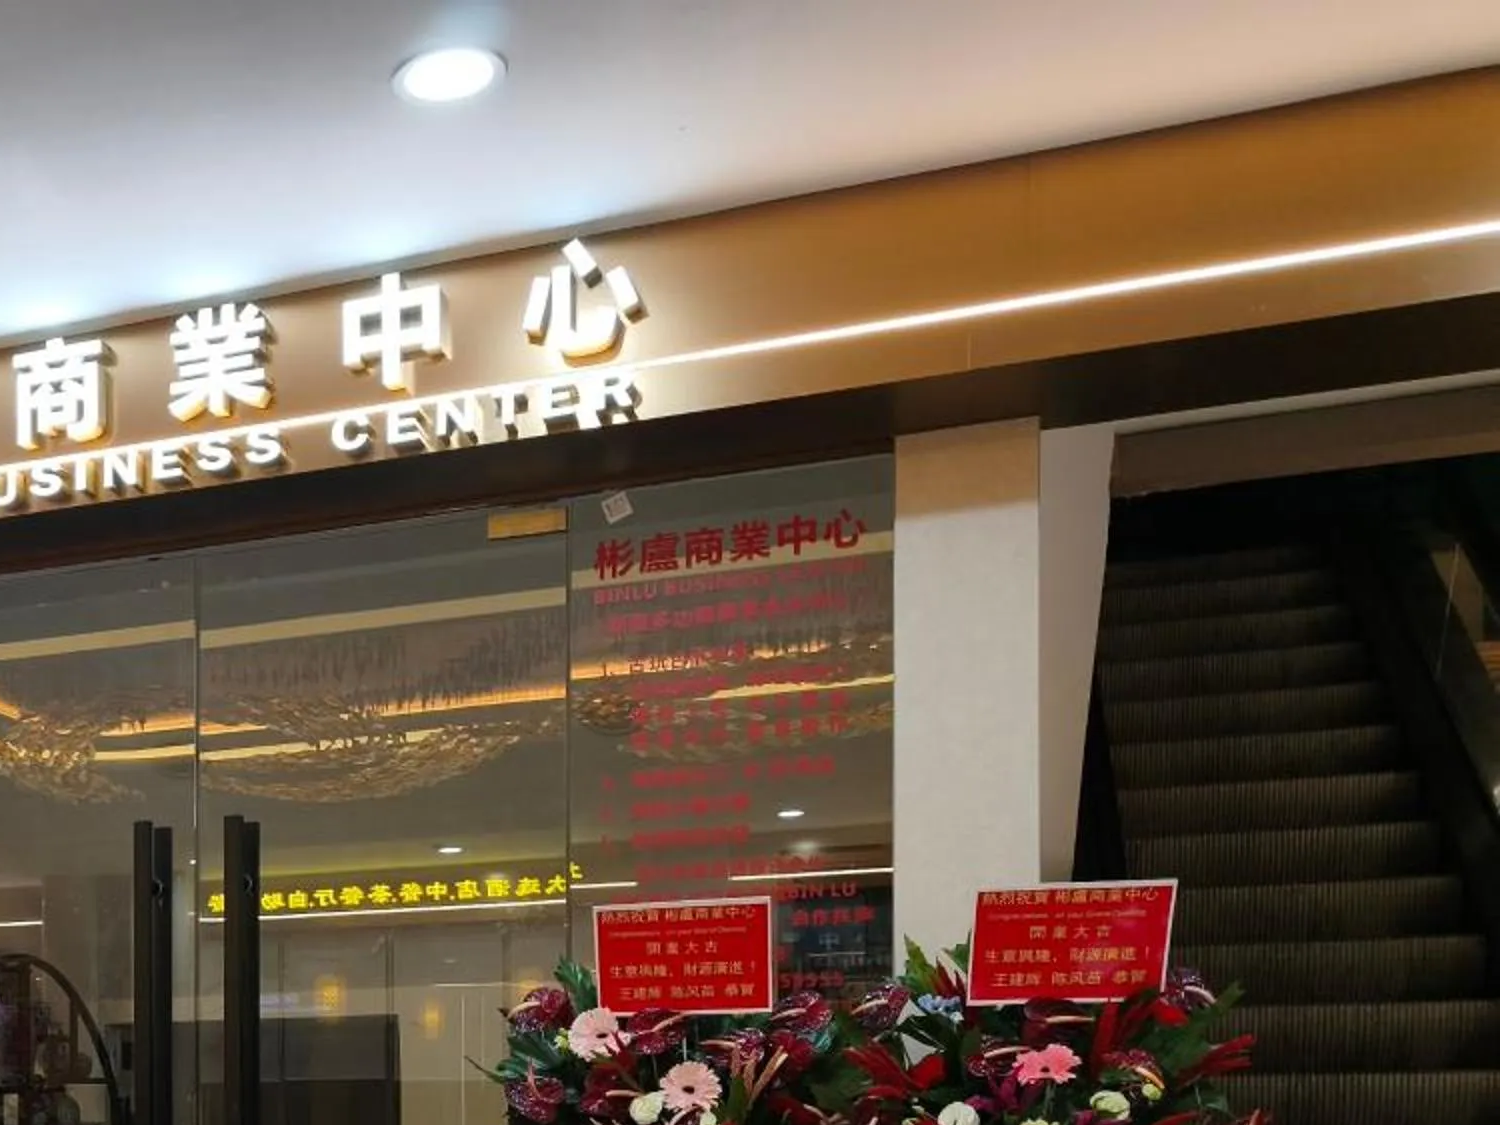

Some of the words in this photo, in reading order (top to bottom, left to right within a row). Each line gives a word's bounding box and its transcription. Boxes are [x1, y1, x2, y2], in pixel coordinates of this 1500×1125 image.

[330, 373, 638, 451] CENTER
[594, 508, 867, 582] 彬盧商業中心
